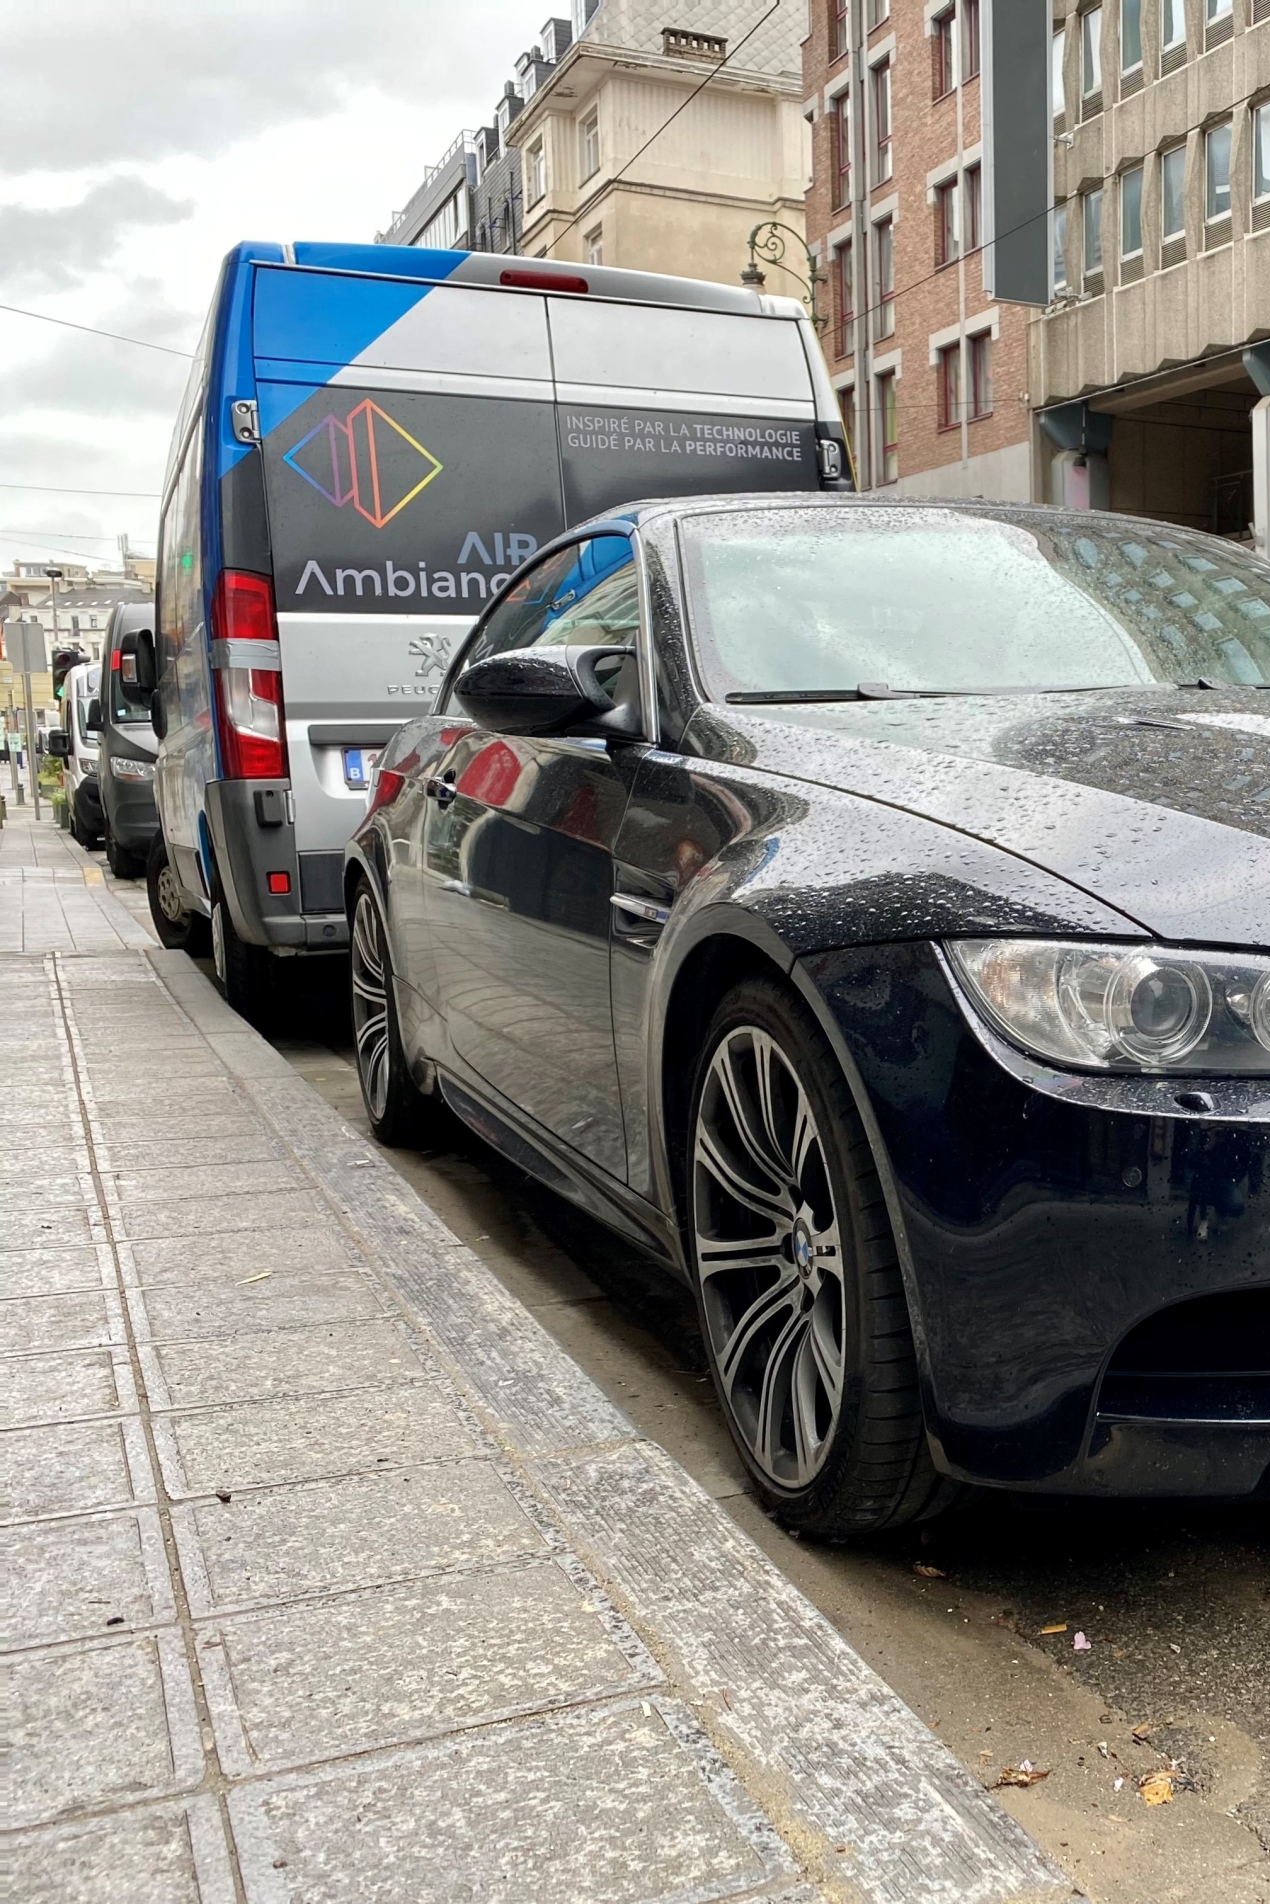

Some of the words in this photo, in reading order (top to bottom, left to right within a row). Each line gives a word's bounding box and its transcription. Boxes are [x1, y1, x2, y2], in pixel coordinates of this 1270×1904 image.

[566, 415, 630, 433] INSPIRÉ
[635, 420, 665, 435] PAR
[670, 422, 690, 437] LA
[693, 424, 801, 444] TECHNOLOGIE
[568, 433, 619, 450] GUIDÉ
[625, 437, 655, 451] PAR
[661, 440, 681, 453] LA
[686, 441, 802, 460] PERFORMANCE
[457, 531, 538, 566] AIR
[349, 767, 361, 779] B
